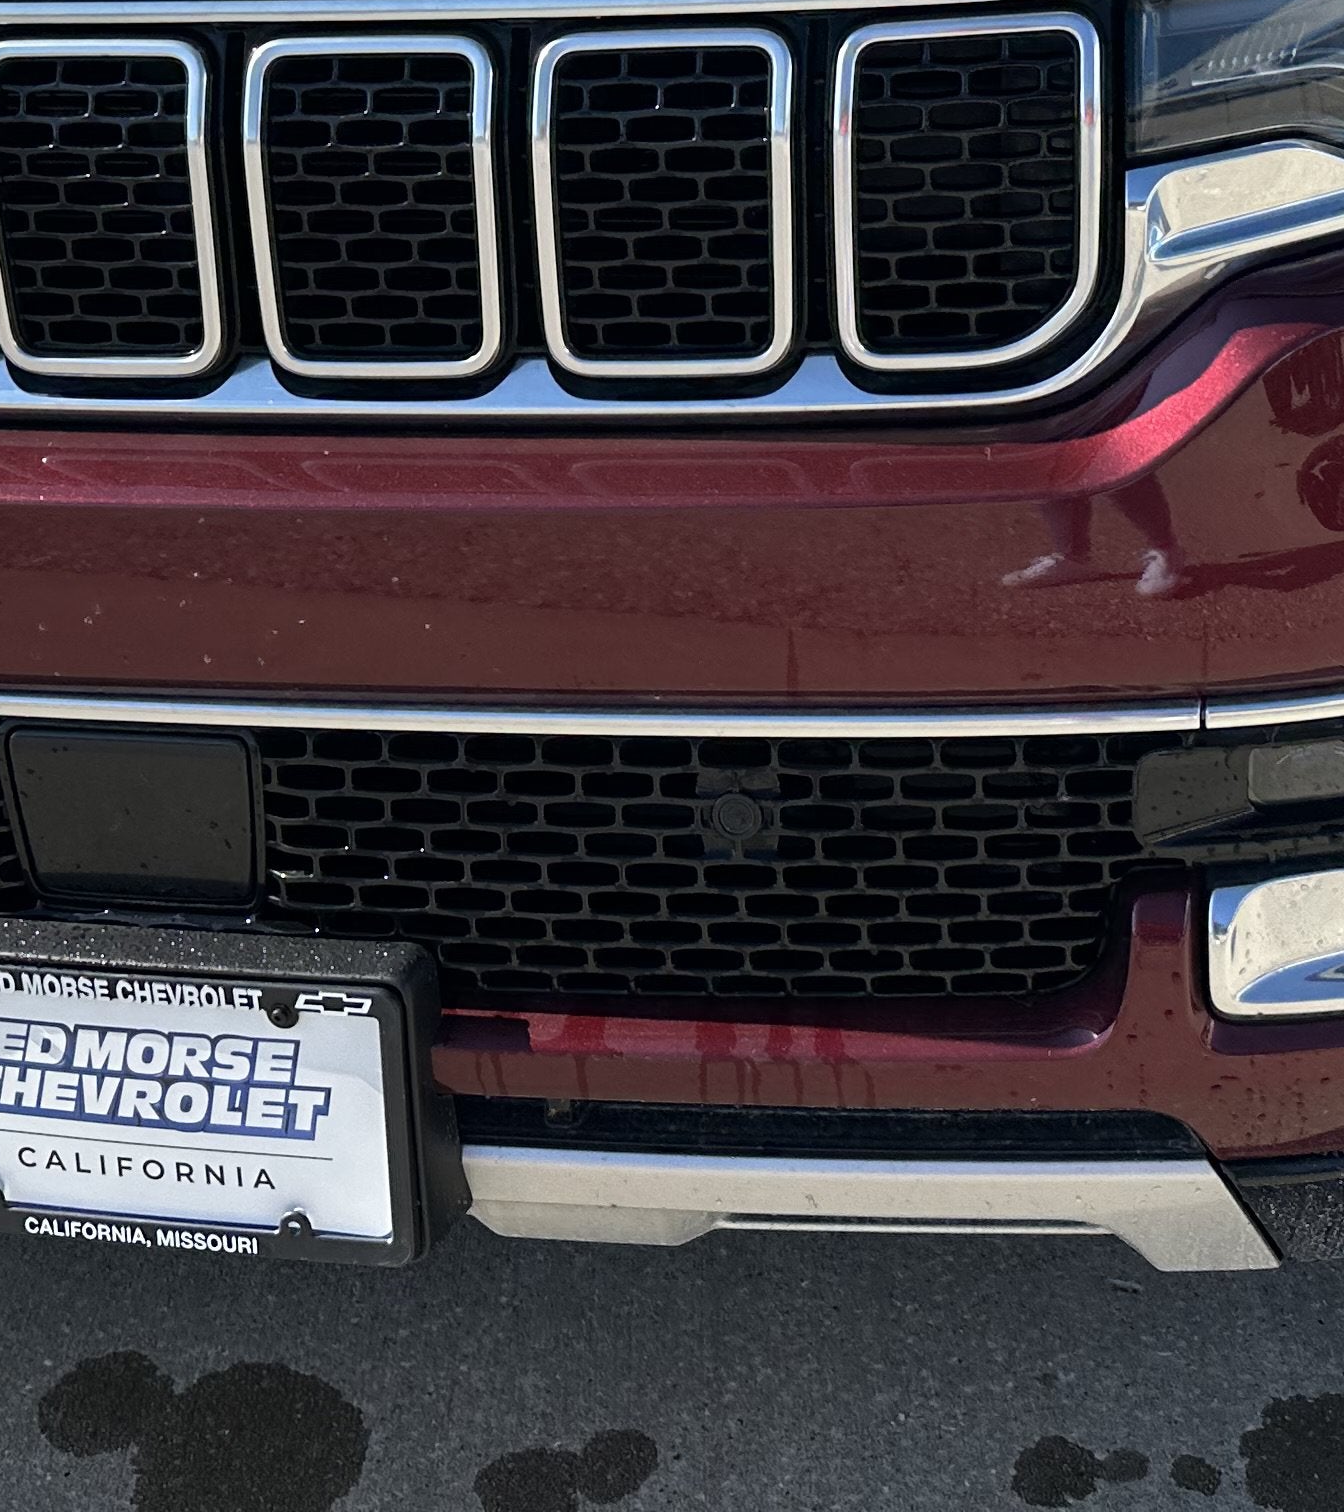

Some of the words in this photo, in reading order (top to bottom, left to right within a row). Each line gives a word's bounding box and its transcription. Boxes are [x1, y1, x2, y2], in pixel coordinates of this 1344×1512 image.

[21, 972, 109, 1000] MORSE
[115, 979, 263, 1011] CHEVROLET
[72, 1026, 297, 1085] MORSE
[17, 1146, 277, 1190] CALIFORNIA
[24, 1216, 153, 1248] CALIFORNIA,
[156, 1228, 259, 1255] MISSOURI
